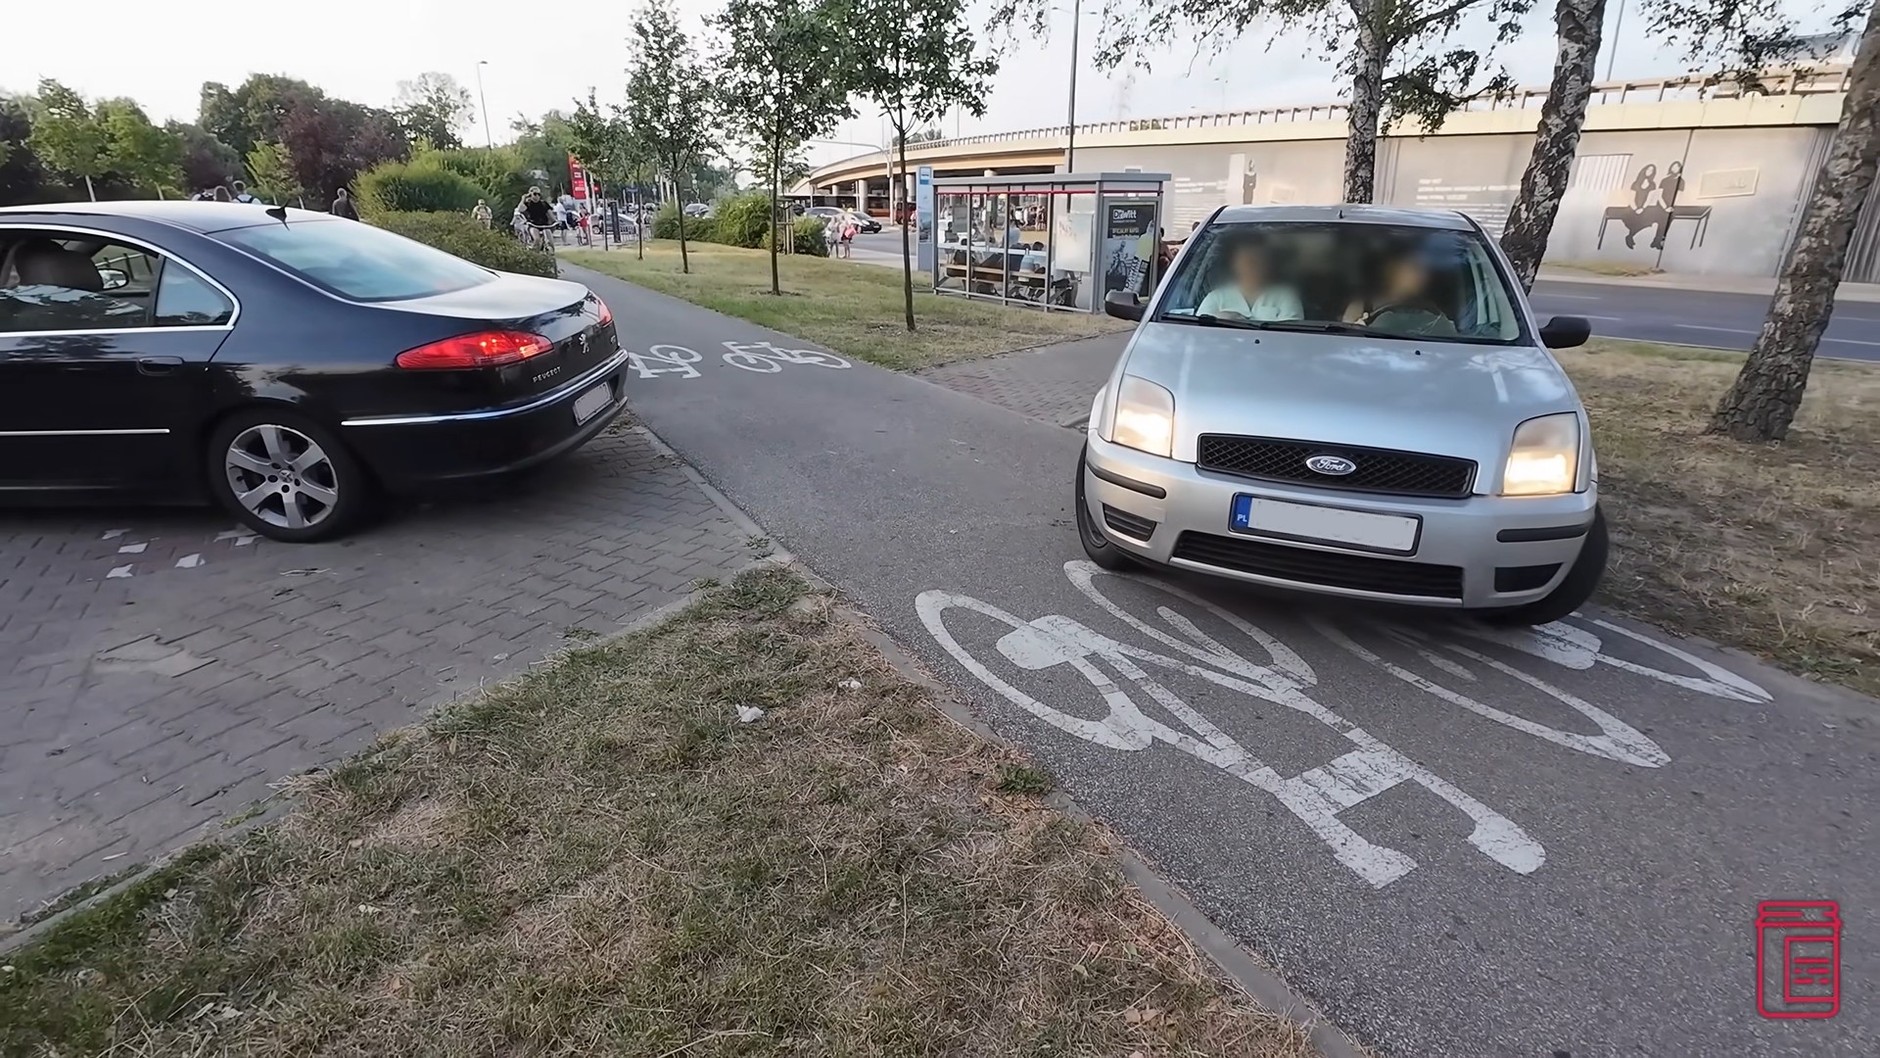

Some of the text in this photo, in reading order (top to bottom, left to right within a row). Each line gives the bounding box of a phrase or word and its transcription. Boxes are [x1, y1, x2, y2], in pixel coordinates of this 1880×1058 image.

[532, 366, 561, 383] PEUGEOT
[1317, 459, 1346, 471] Ford
[1237, 513, 1248, 523] PL
